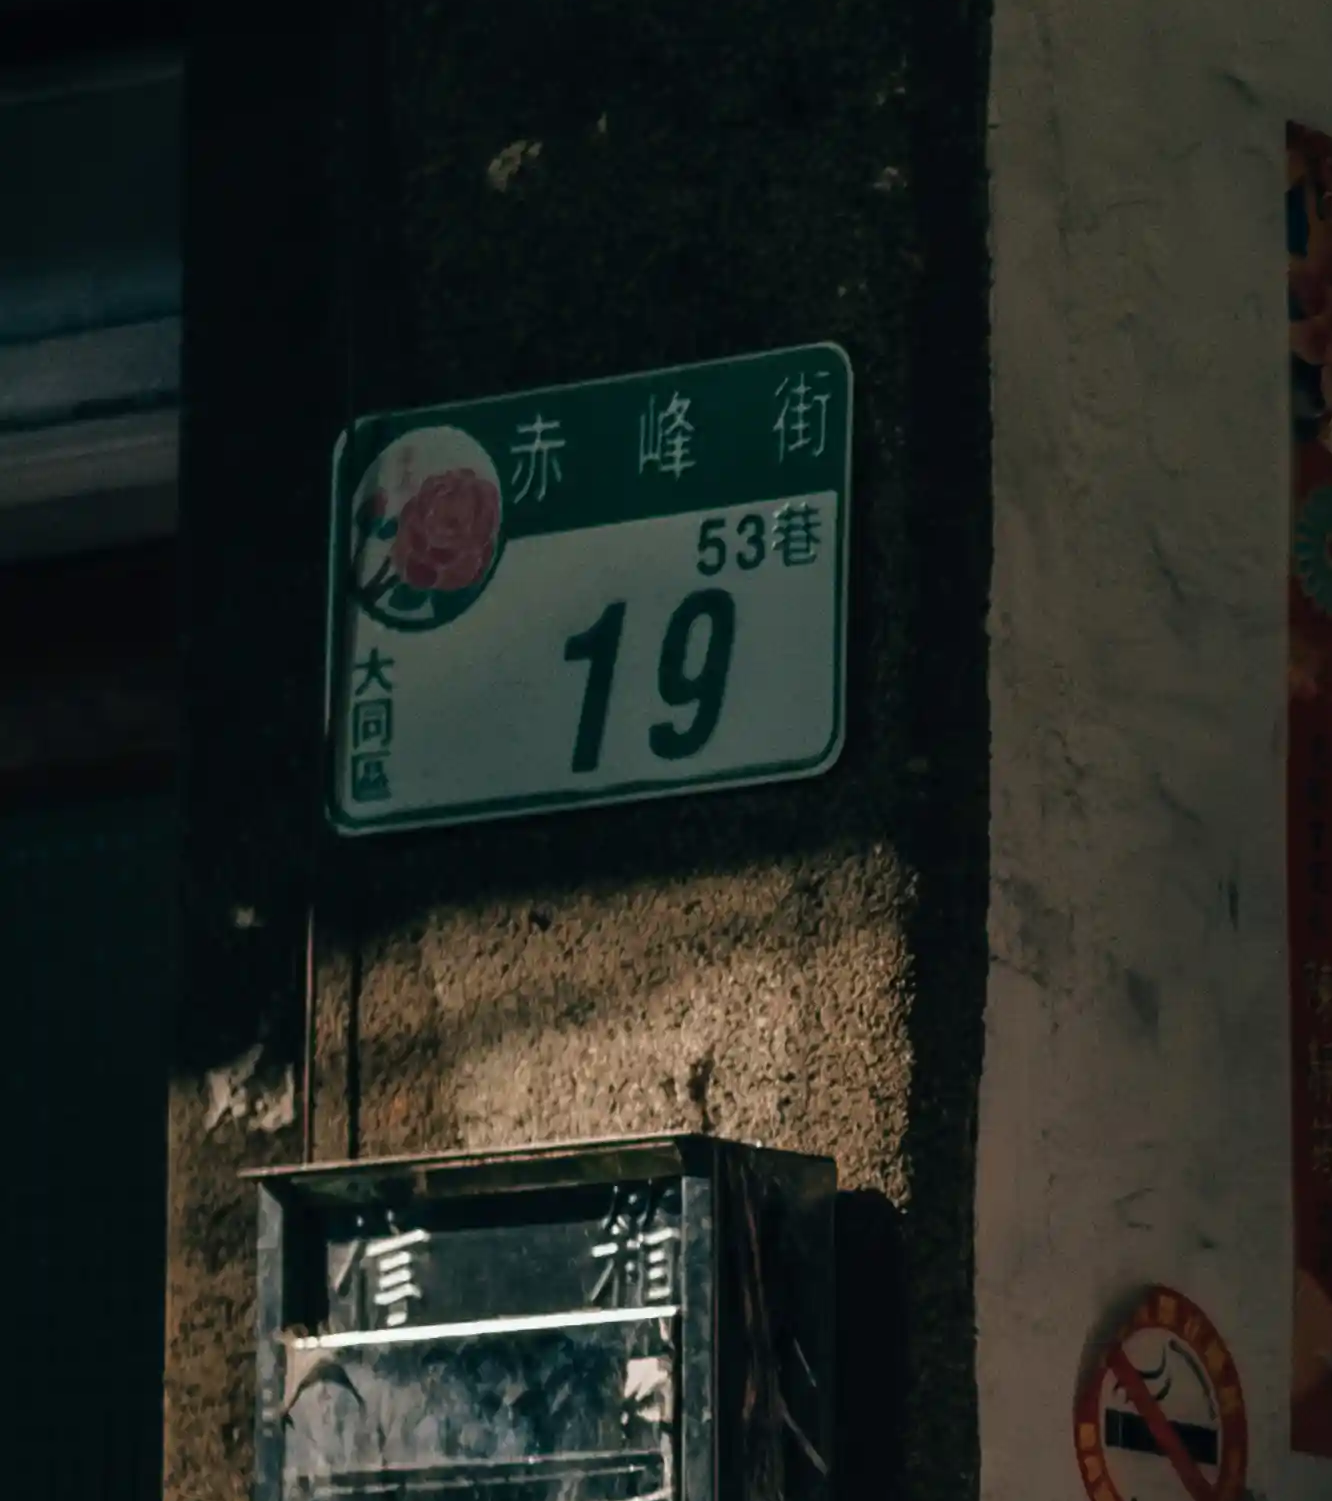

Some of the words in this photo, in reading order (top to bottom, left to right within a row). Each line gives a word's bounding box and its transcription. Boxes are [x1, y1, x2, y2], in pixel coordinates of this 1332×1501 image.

[510, 368, 831, 504] 赤峰街
[696, 501, 823, 577] 53巷
[351, 647, 396, 802] 大同區
[563, 586, 738, 774] 19
